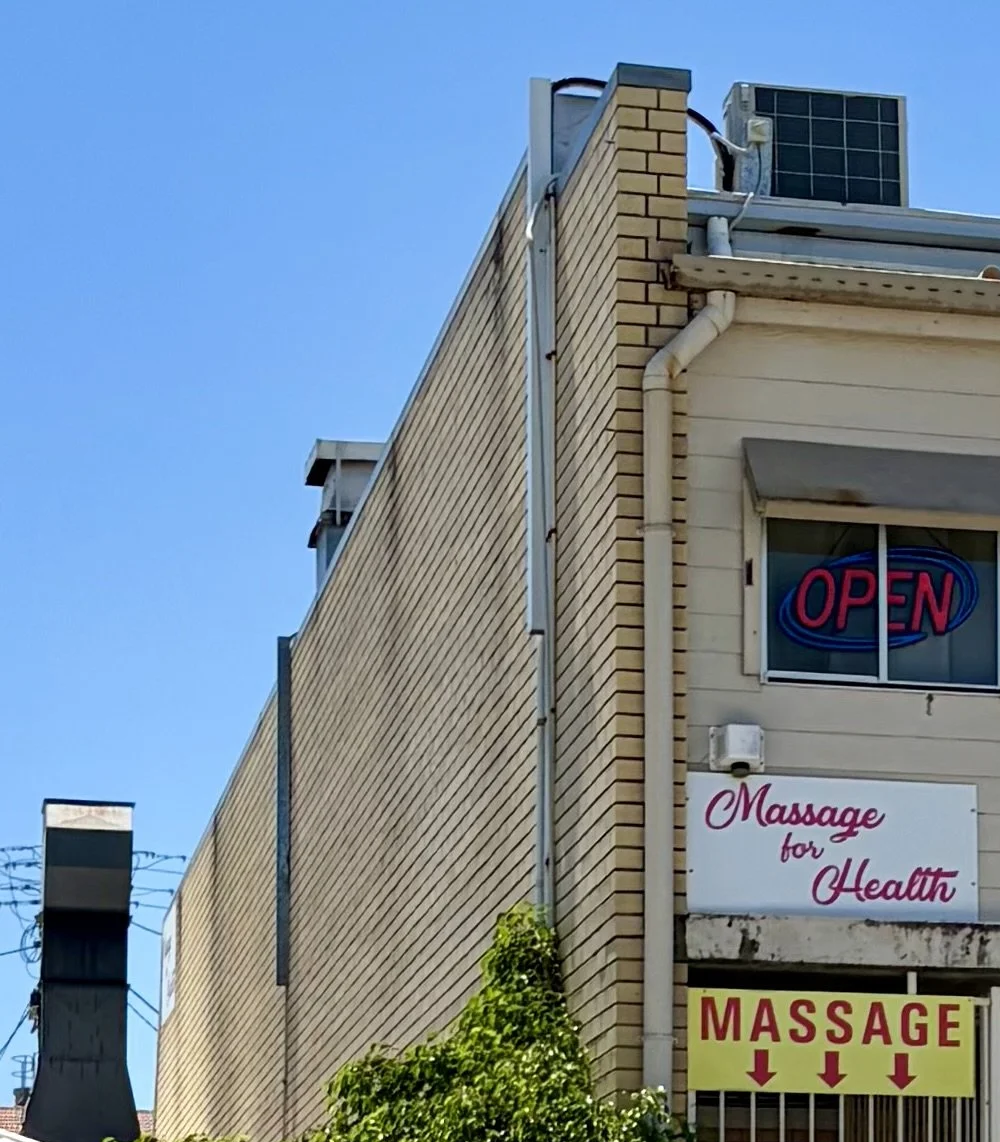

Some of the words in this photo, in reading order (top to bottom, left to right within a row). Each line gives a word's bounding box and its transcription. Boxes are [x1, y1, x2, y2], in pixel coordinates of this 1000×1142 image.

[793, 567, 956, 635] OPEN
[705, 783, 886, 844] Massage
[780, 832, 825, 863] for
[812, 858, 959, 906] Health
[699, 996, 962, 1049] MASSAGE
